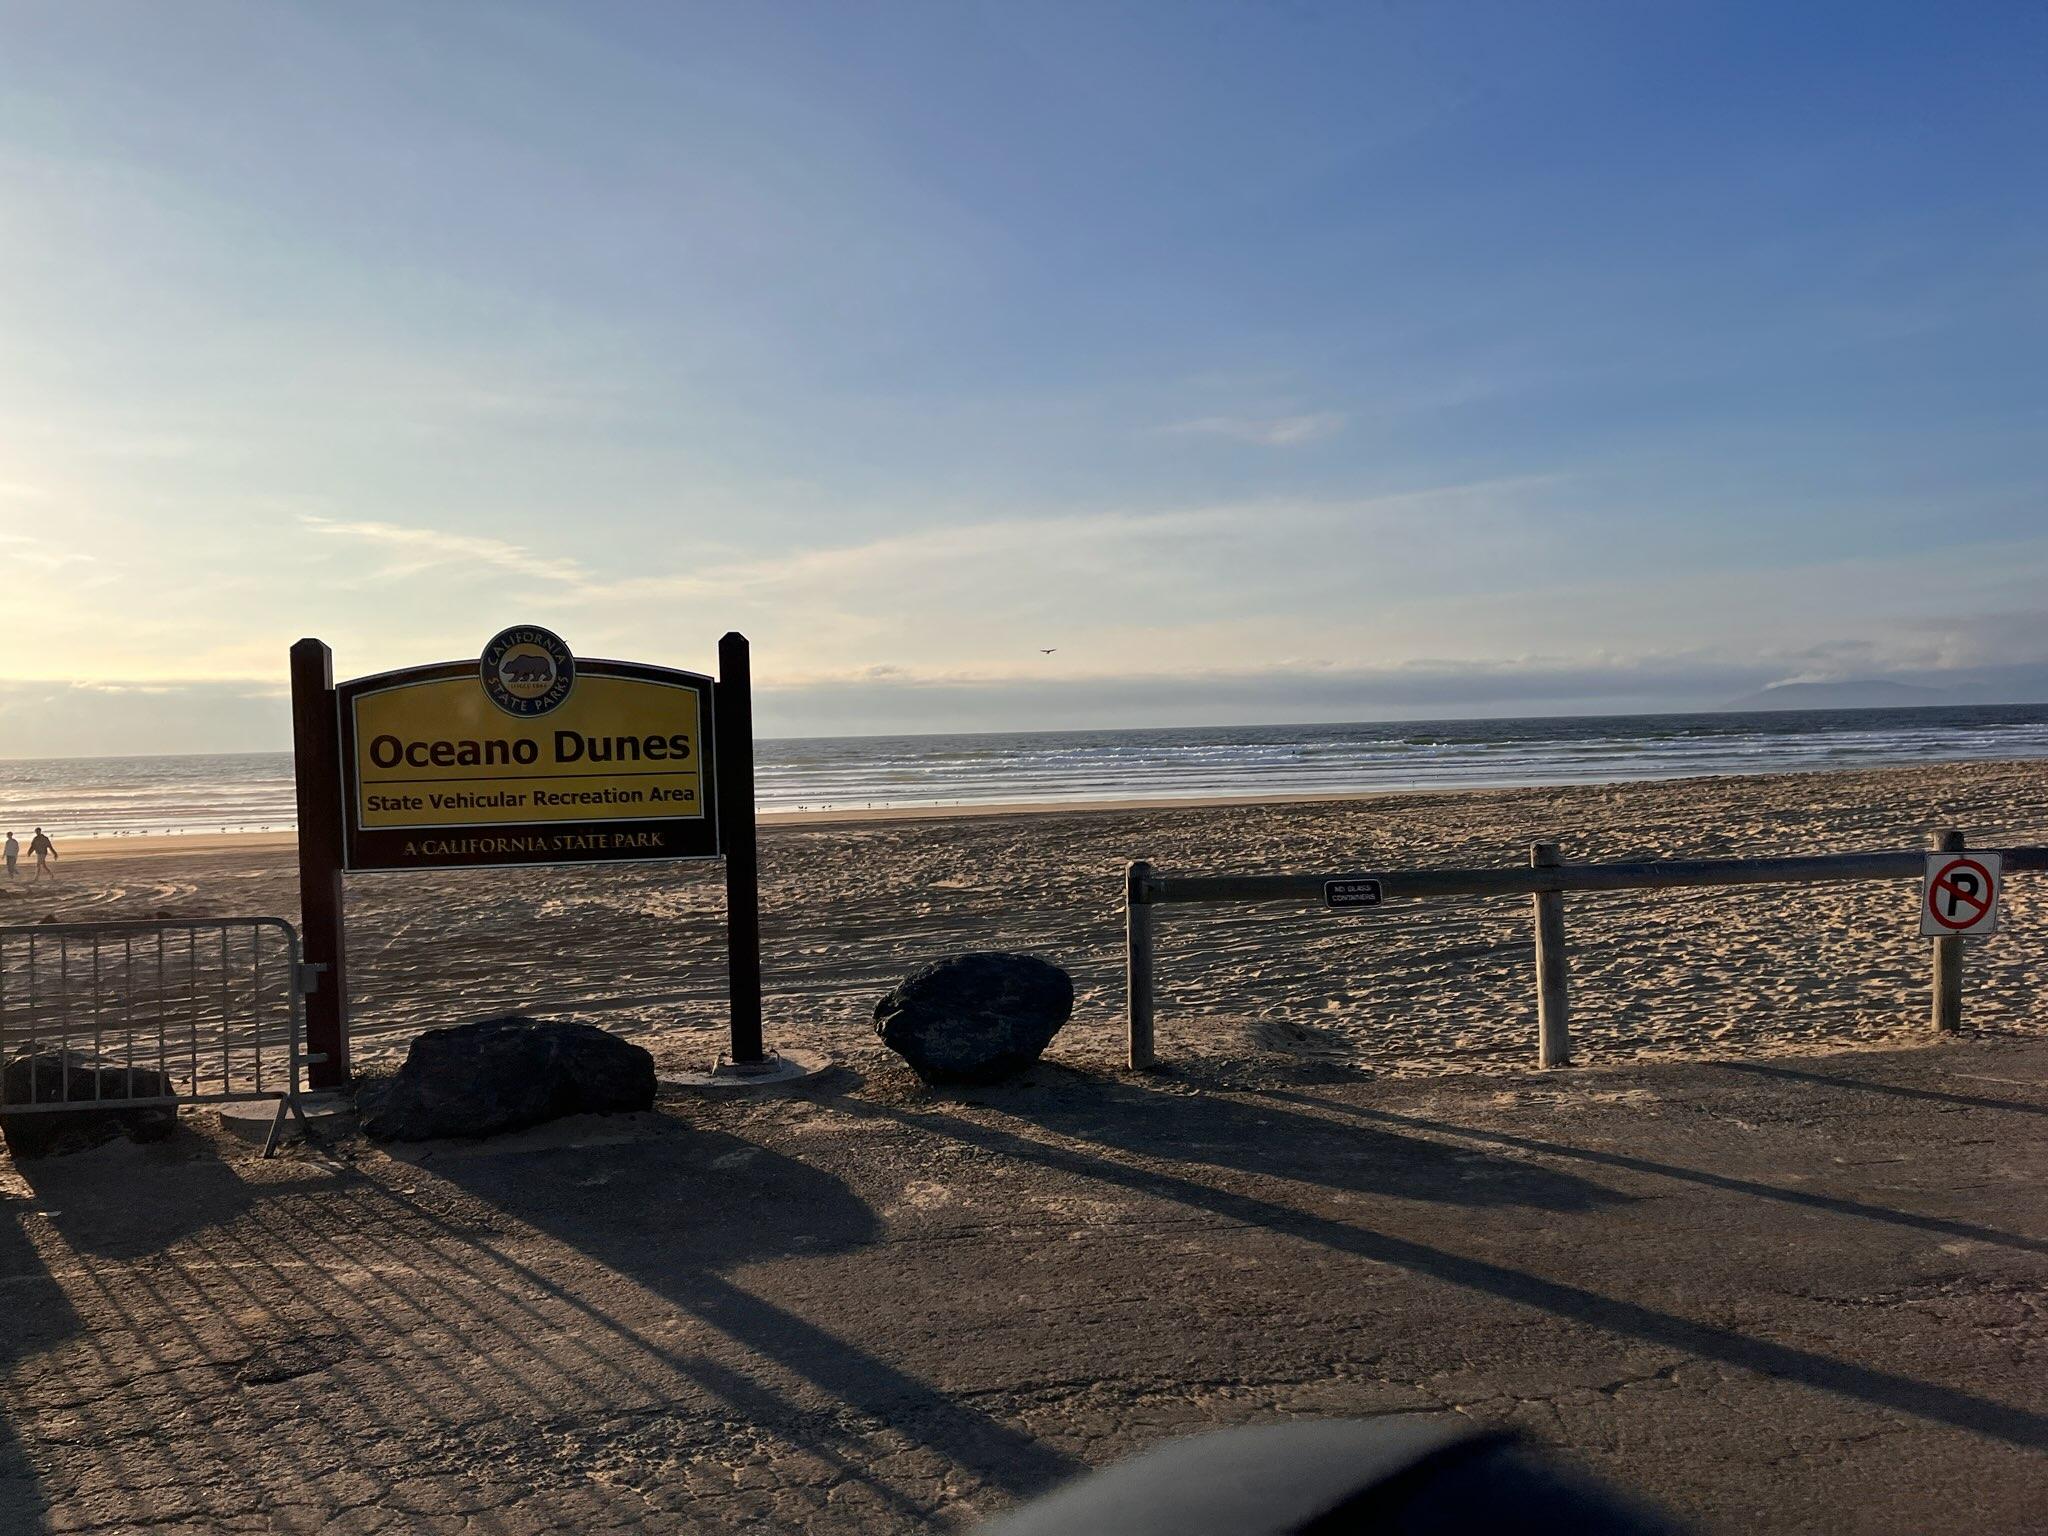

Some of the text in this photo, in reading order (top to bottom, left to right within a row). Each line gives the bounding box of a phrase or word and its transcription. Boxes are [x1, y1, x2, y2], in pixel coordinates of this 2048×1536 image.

[487, 631, 566, 666] CALIFORNIA
[488, 675, 569, 711] STATE PARKS
[370, 730, 690, 768] Oceano Dunes
[367, 787, 695, 811] State Vehicular Recreation Area
[403, 832, 664, 856] A CALIFORNIA STATE PARK
[1948, 873, 1979, 916] P
